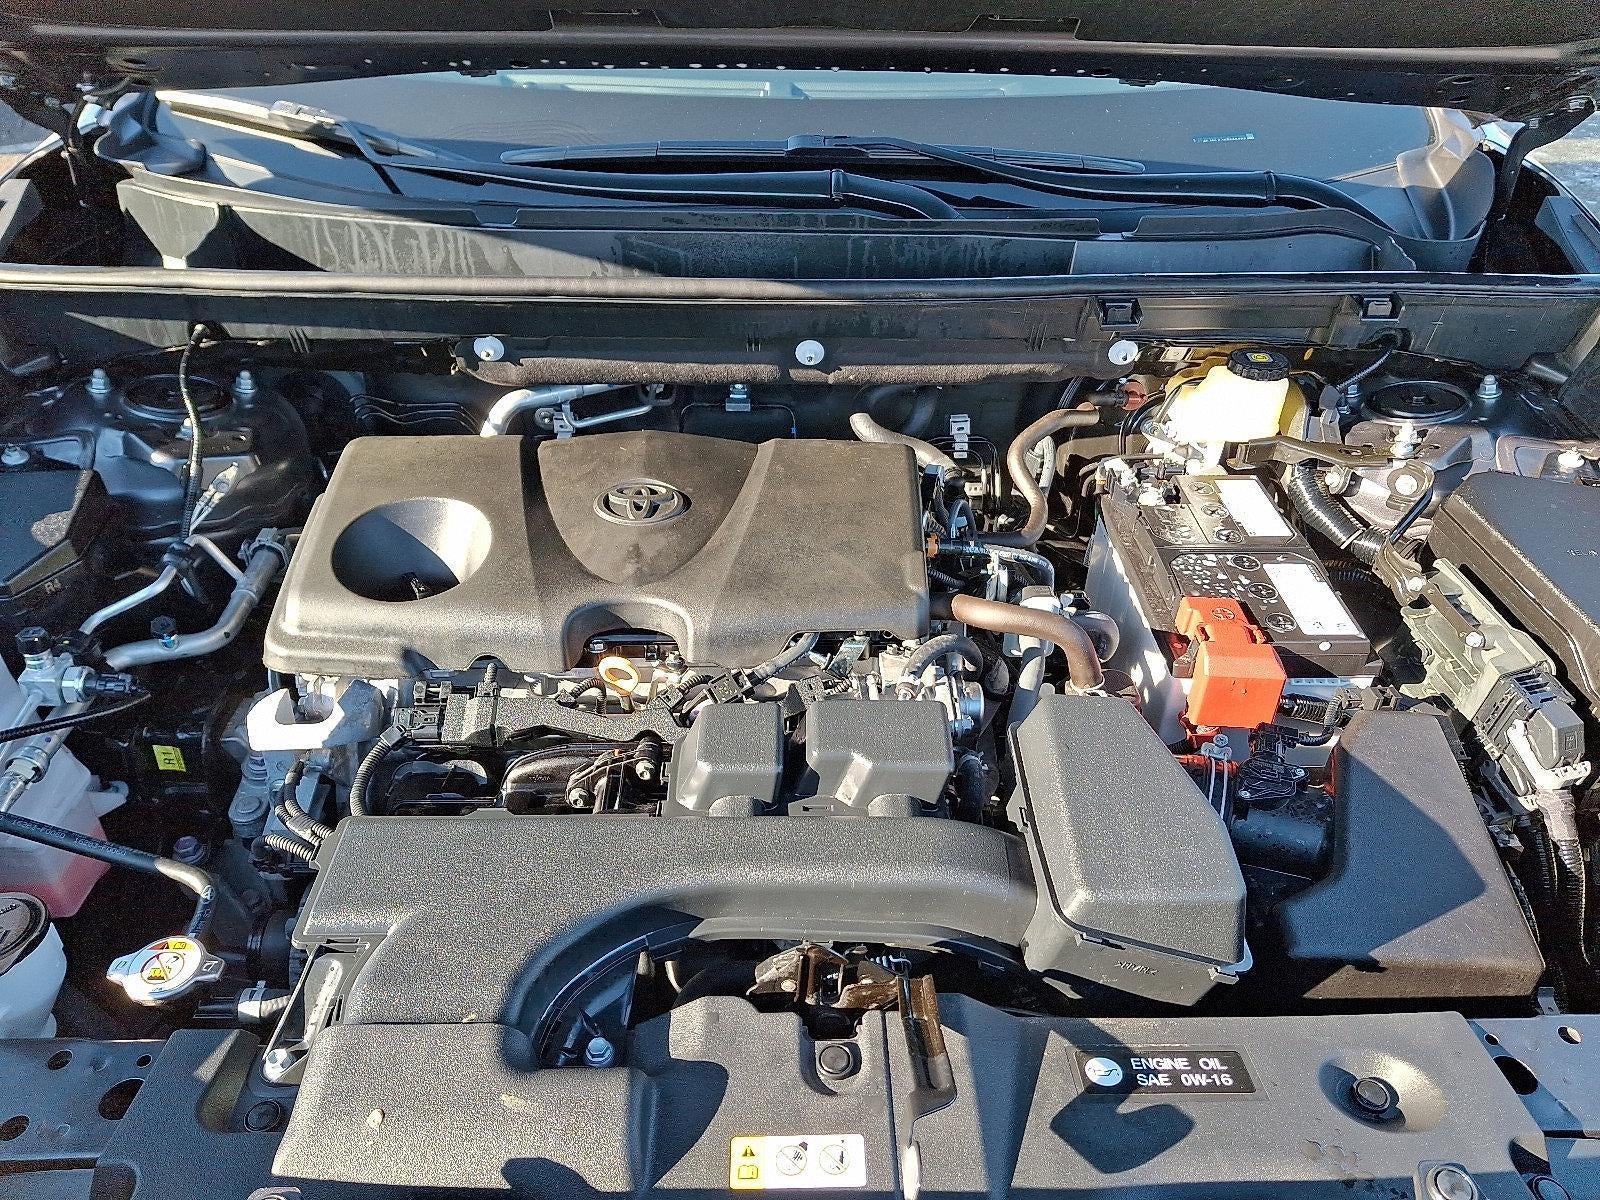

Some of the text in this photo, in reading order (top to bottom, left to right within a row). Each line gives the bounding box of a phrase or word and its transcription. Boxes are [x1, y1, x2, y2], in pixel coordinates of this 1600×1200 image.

[44, 578, 62, 595] R4
[1130, 1057, 1228, 1071] ENGINE OIL
[1137, 1073, 1234, 1087] SAE 0W-16
